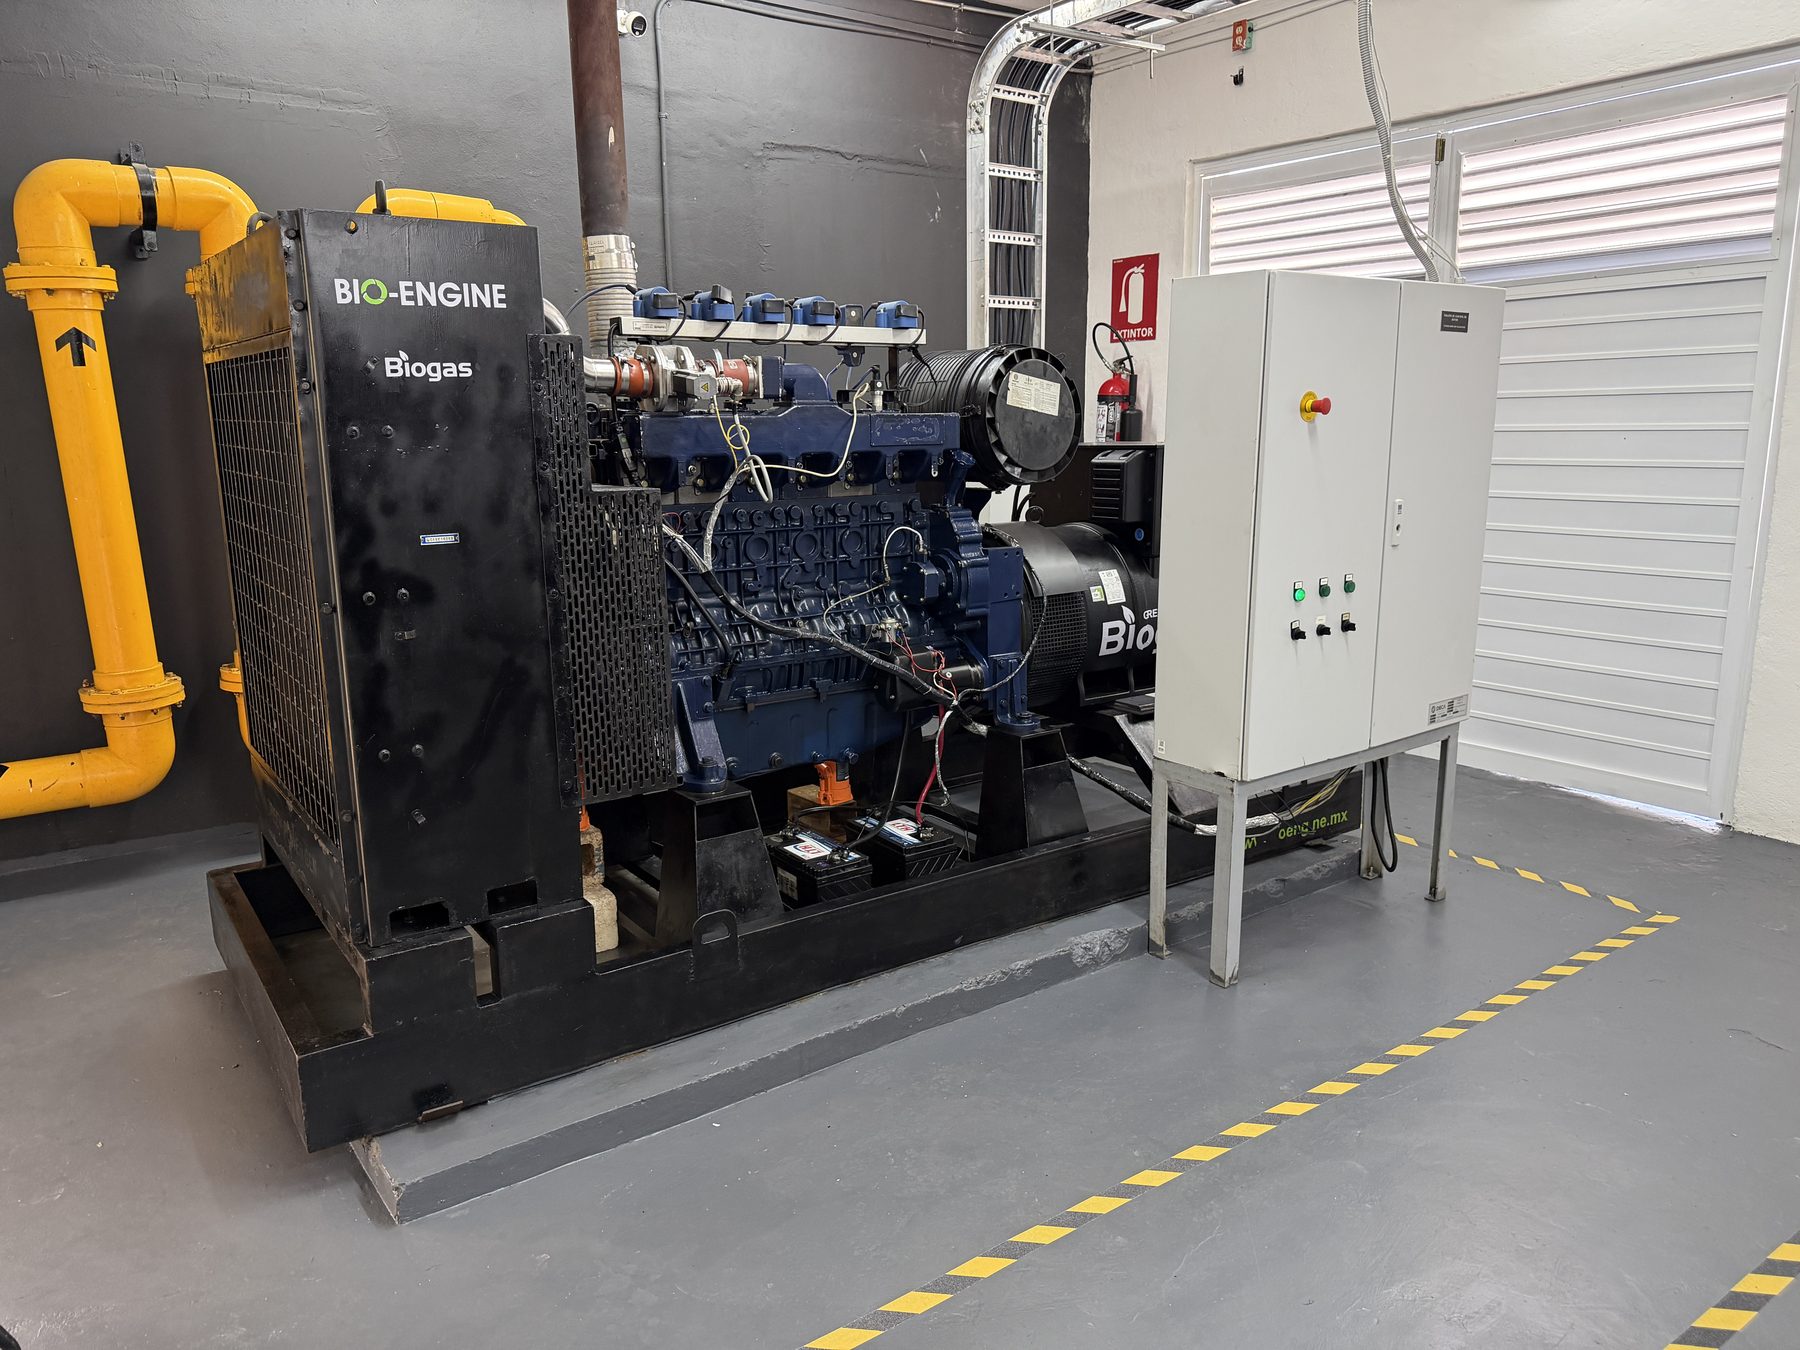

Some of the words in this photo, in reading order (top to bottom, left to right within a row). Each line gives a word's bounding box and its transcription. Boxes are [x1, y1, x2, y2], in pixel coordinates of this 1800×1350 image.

[334, 278, 507, 308] BIO-ENGINE
[384, 350, 473, 382] Biogas
[1099, 605, 1158, 656] Bio
